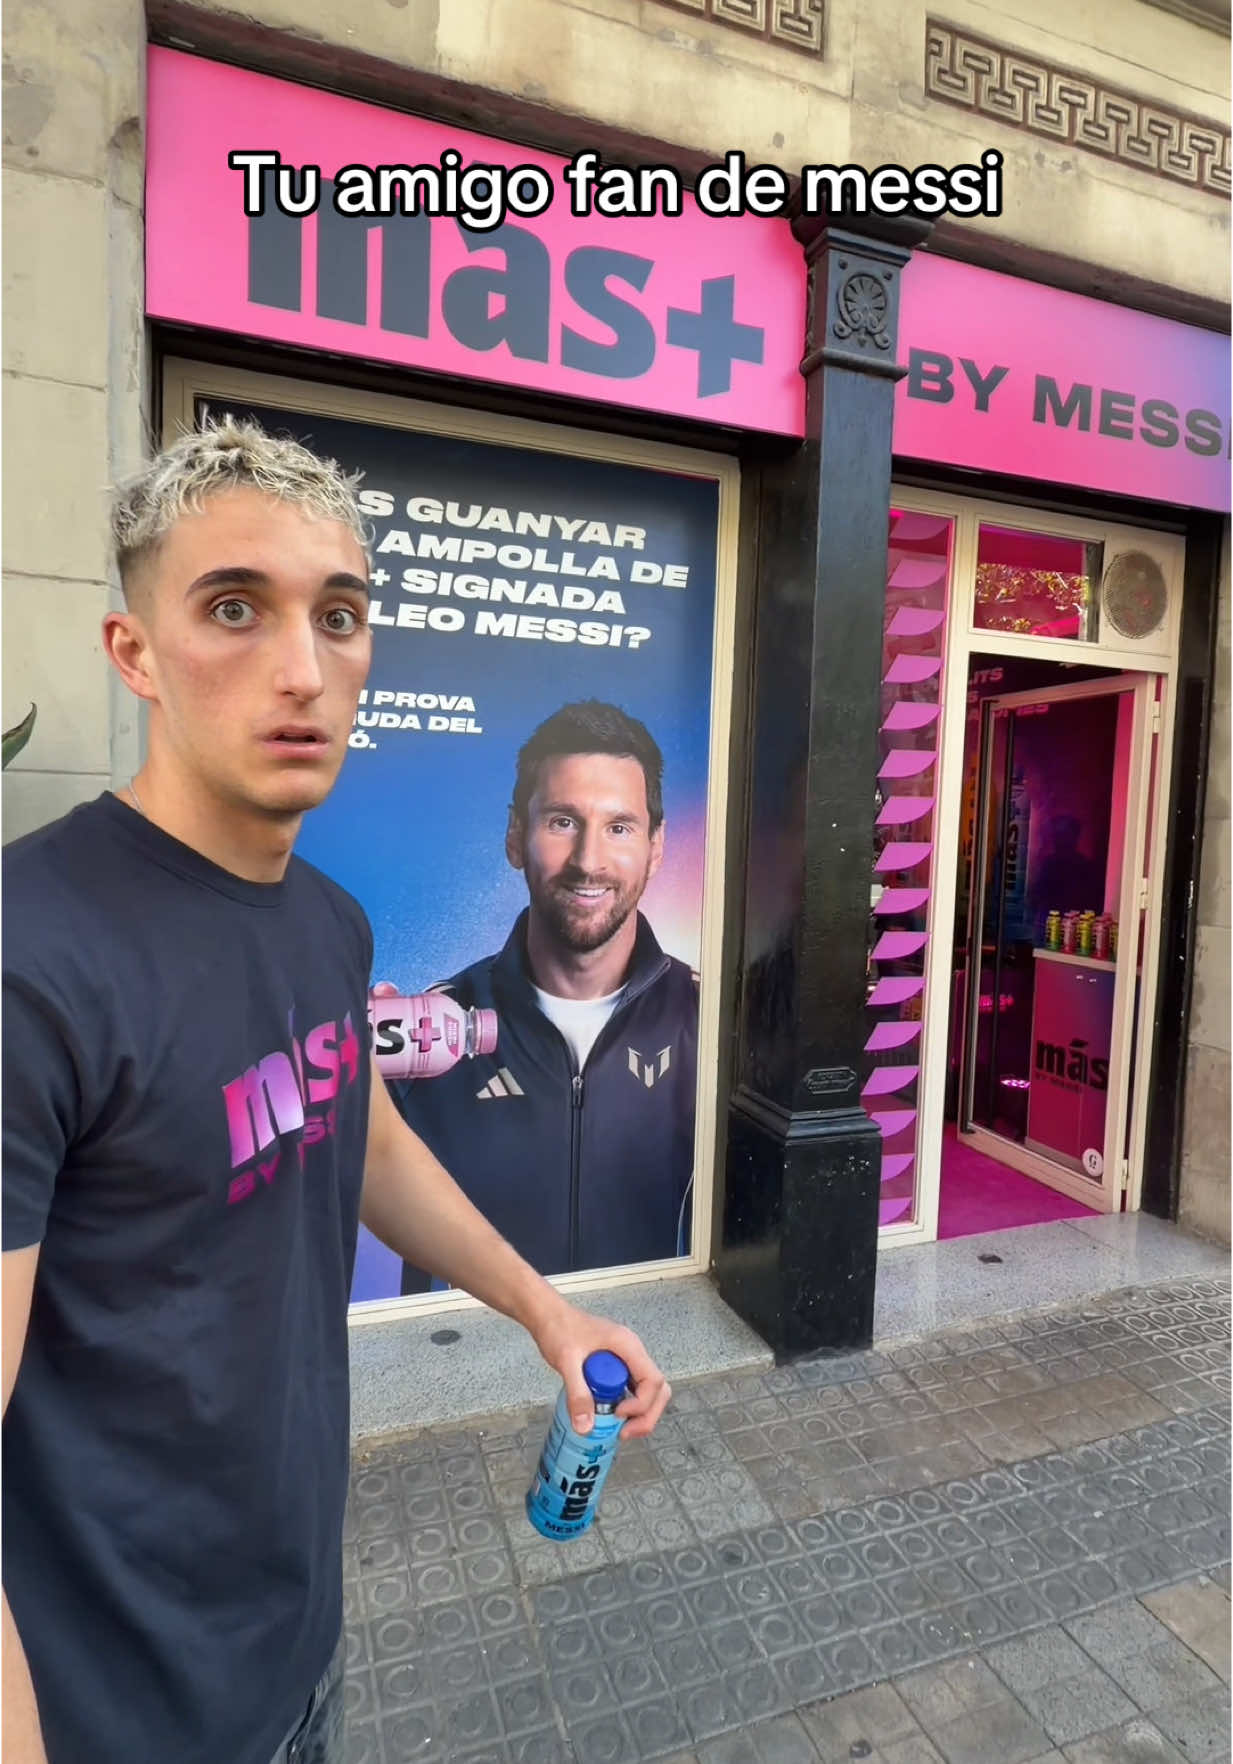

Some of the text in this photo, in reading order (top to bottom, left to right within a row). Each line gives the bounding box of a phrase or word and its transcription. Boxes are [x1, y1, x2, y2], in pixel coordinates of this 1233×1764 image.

[906, 346, 1231, 461] BY MESS
[357, 489, 647, 550] S GUANYAR
[376, 529, 690, 588] AMPOLLA DE
[400, 568, 626, 614] SIGNADA
[367, 600, 651, 649] LEO MESSI?
[352, 711, 483, 734] UDA DEL
[373, 690, 476, 712] PROVA
[347, 729, 378, 749] Ó.
[558, 1444, 607, 1521] más+
